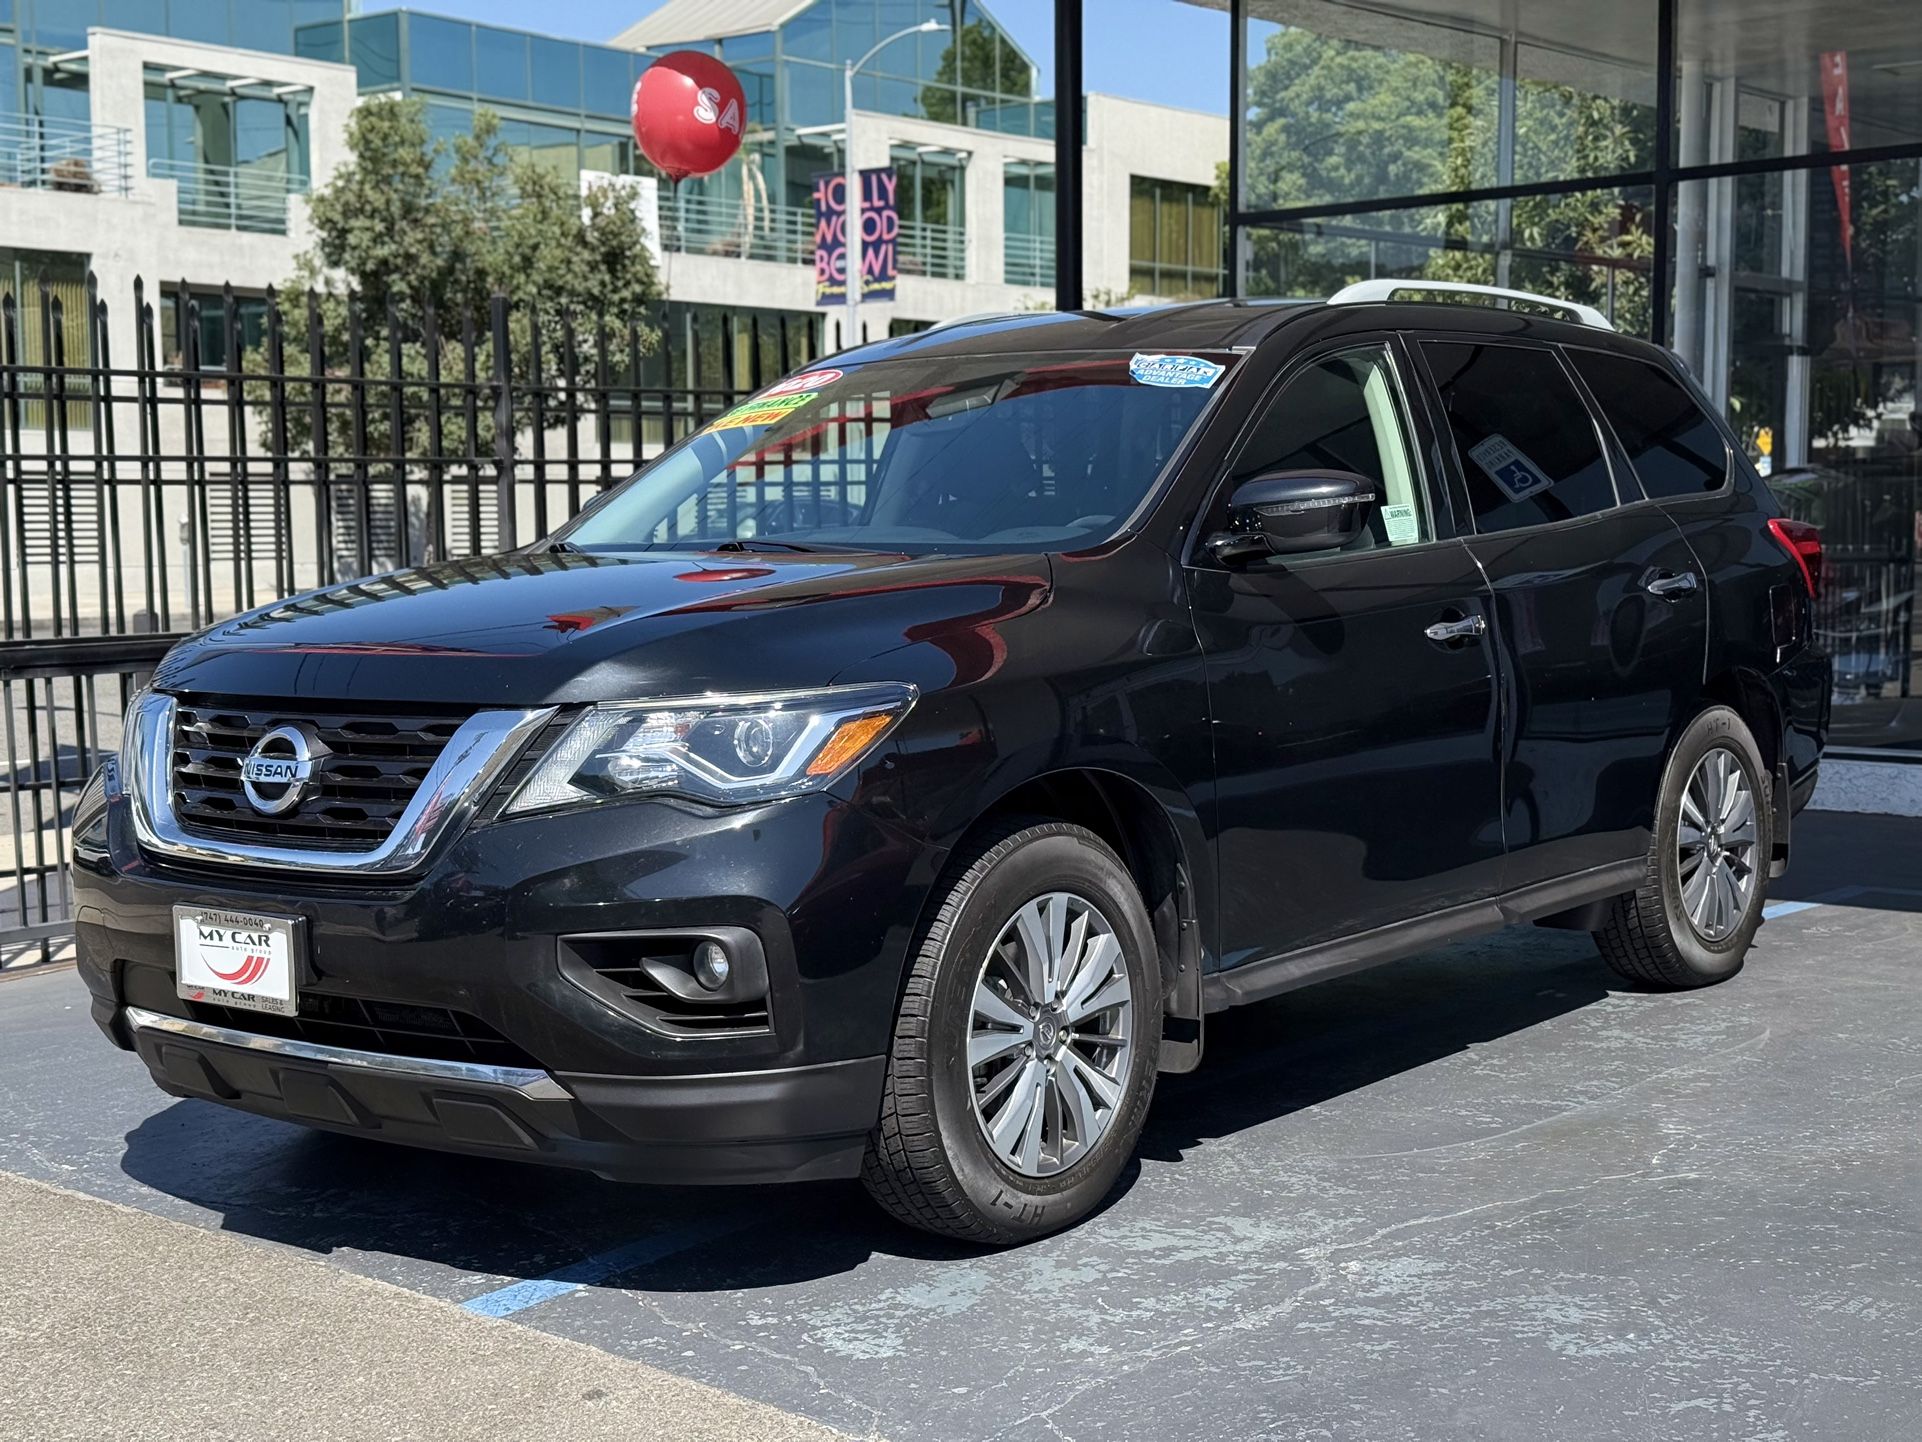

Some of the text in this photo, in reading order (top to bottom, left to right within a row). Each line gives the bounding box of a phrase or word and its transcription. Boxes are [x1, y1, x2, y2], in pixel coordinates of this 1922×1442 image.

[815, 242, 898, 283] BOWL
[1136, 368, 1201, 382] ADVANTAGE
[1142, 375, 1187, 385] DEALER
[244, 762, 299, 778] NISSAN
[201, 912, 265, 929] (747) 444-0040
[199, 928, 271, 948] MY CAR
[213, 988, 256, 1002] MY CAR
[261, 1003, 285, 1013] LEASING
[989, 1189, 1046, 1226] HT-1
